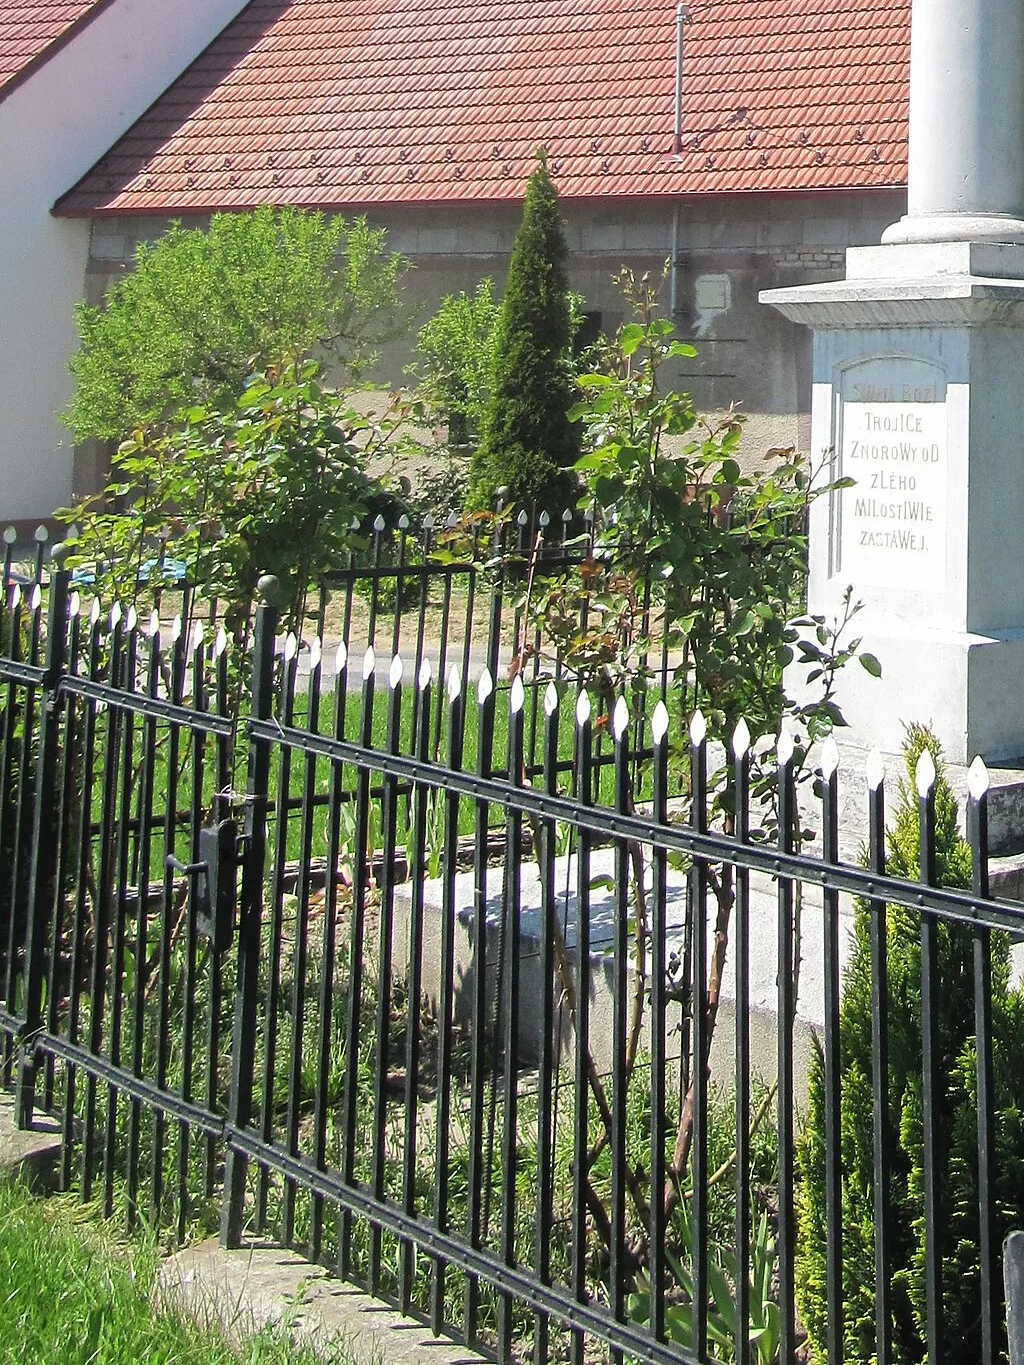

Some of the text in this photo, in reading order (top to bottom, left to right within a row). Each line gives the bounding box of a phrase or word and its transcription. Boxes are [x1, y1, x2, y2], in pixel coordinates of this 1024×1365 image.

[864, 411, 923, 433] TROJICE
[850, 440, 939, 463] ZNOROWY OD
[870, 470, 916, 491] ZLÉHO
